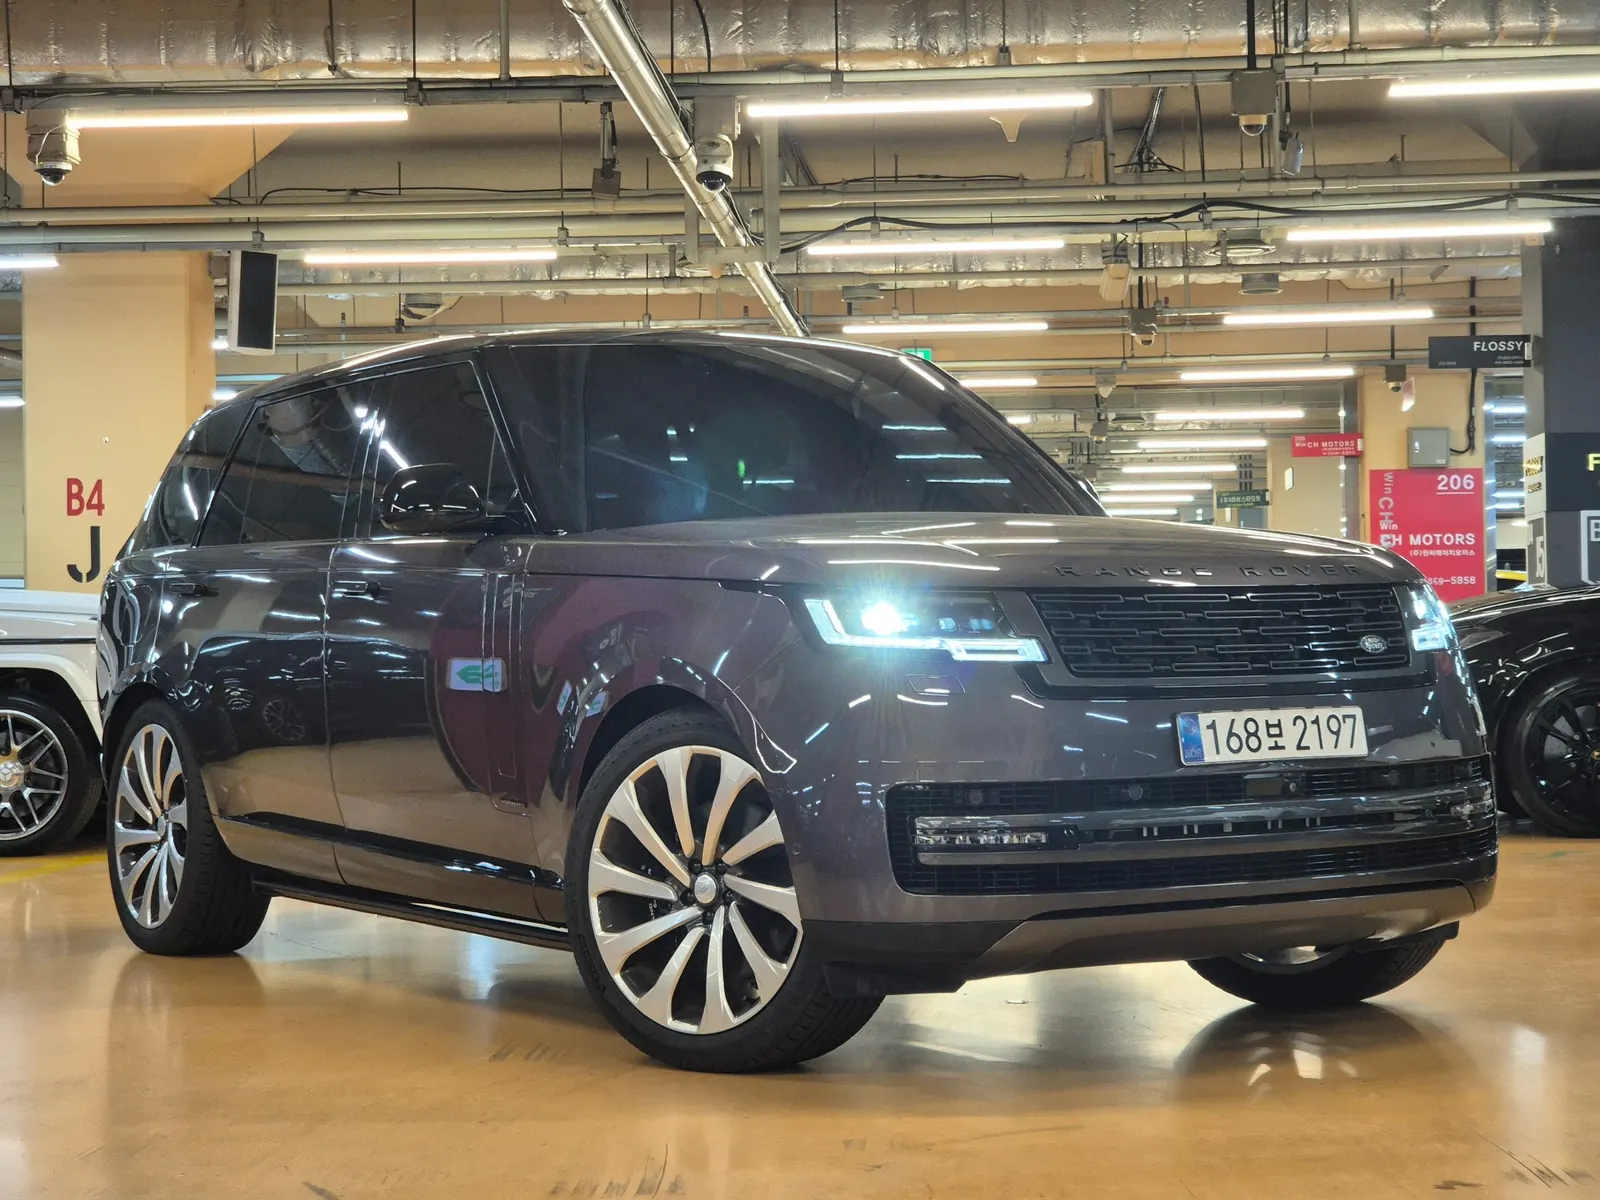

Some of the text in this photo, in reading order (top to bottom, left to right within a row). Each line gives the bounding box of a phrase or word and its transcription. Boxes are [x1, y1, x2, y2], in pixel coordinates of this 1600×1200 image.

[1473, 341, 1523, 351] FLOSSY
[1321, 440, 1355, 448] MOTORS
[1437, 474, 1475, 491] 206
[66, 477, 105, 516] B4
[1380, 522, 1398, 531] Win
[1408, 533, 1476, 546] MOTORS
[66, 525, 101, 583] J
[1053, 563, 1364, 578] RANGE ROVER
[1206, 713, 1358, 756] 168보 2197
